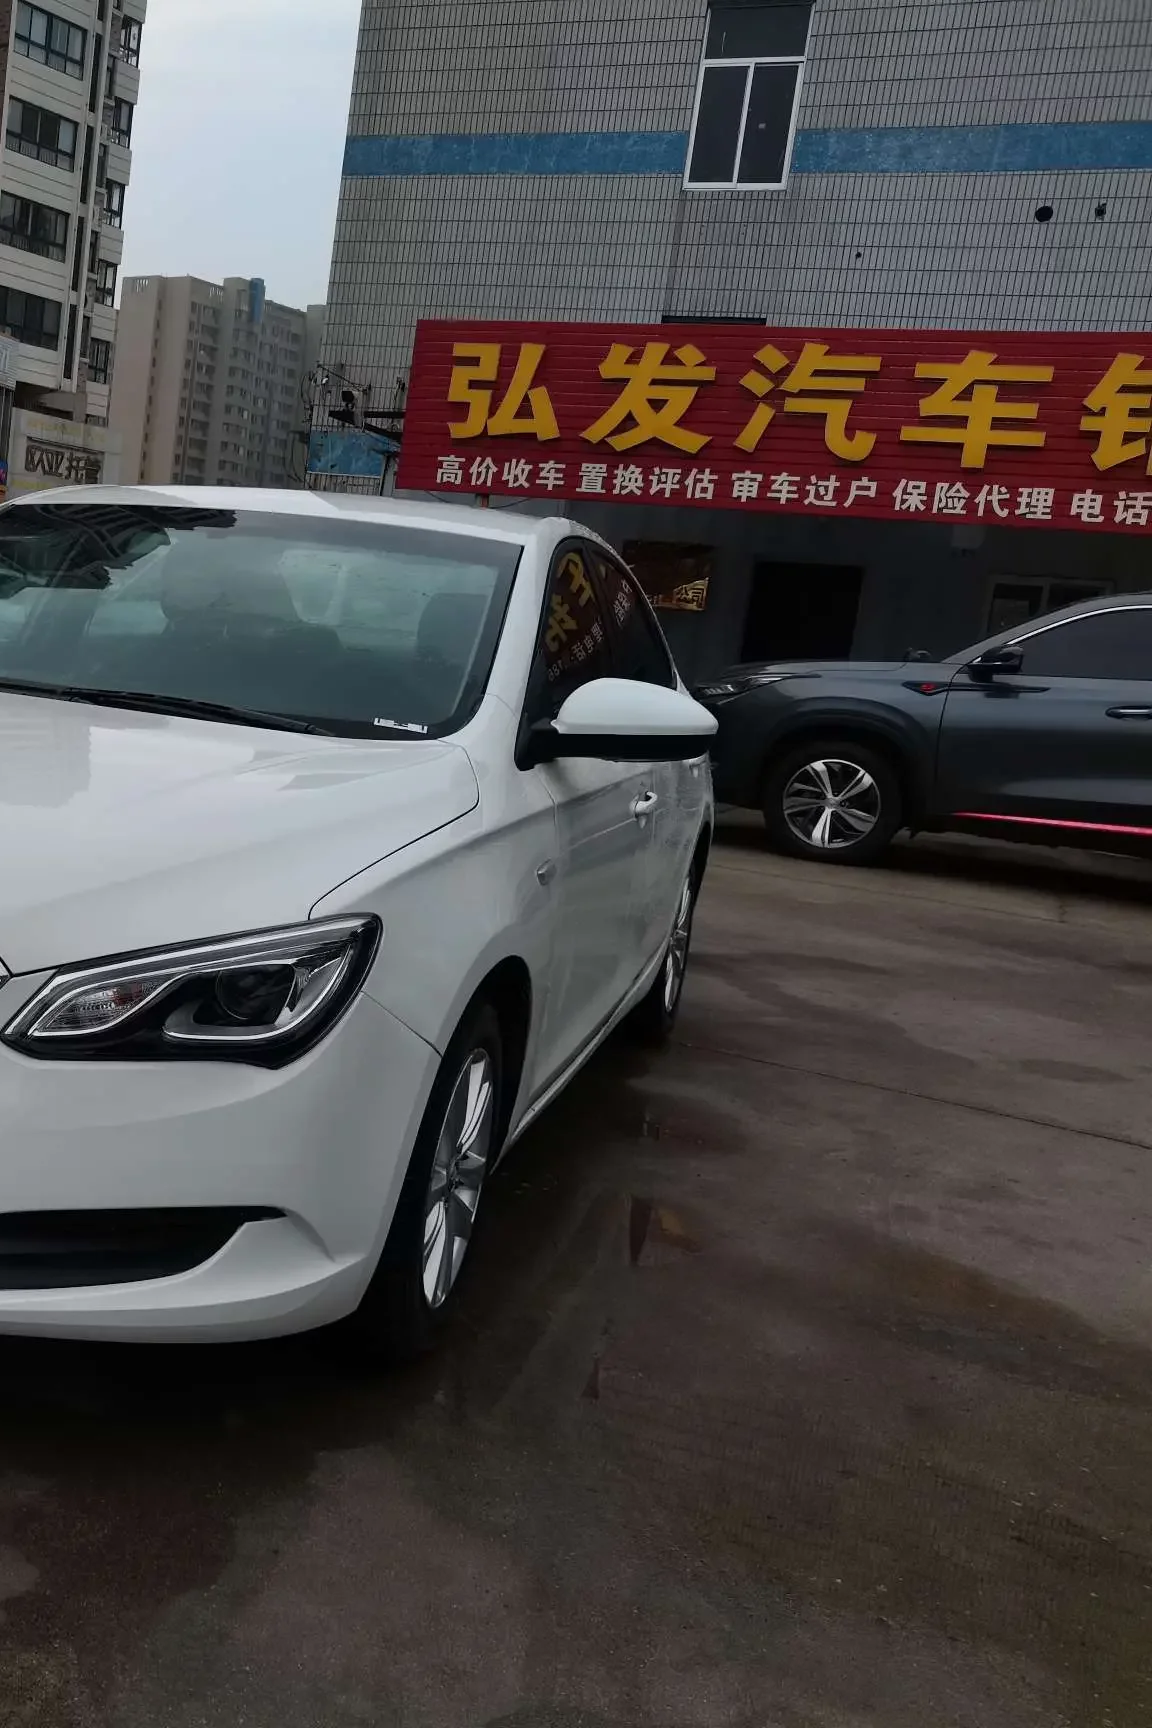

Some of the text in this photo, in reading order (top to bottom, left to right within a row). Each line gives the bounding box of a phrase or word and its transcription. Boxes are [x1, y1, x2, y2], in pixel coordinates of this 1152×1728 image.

[436, 455, 565, 488] 高价收车
[575, 461, 718, 500] 置换评估
[730, 470, 878, 510] 审车过户
[892, 478, 1055, 520] 保险代理
